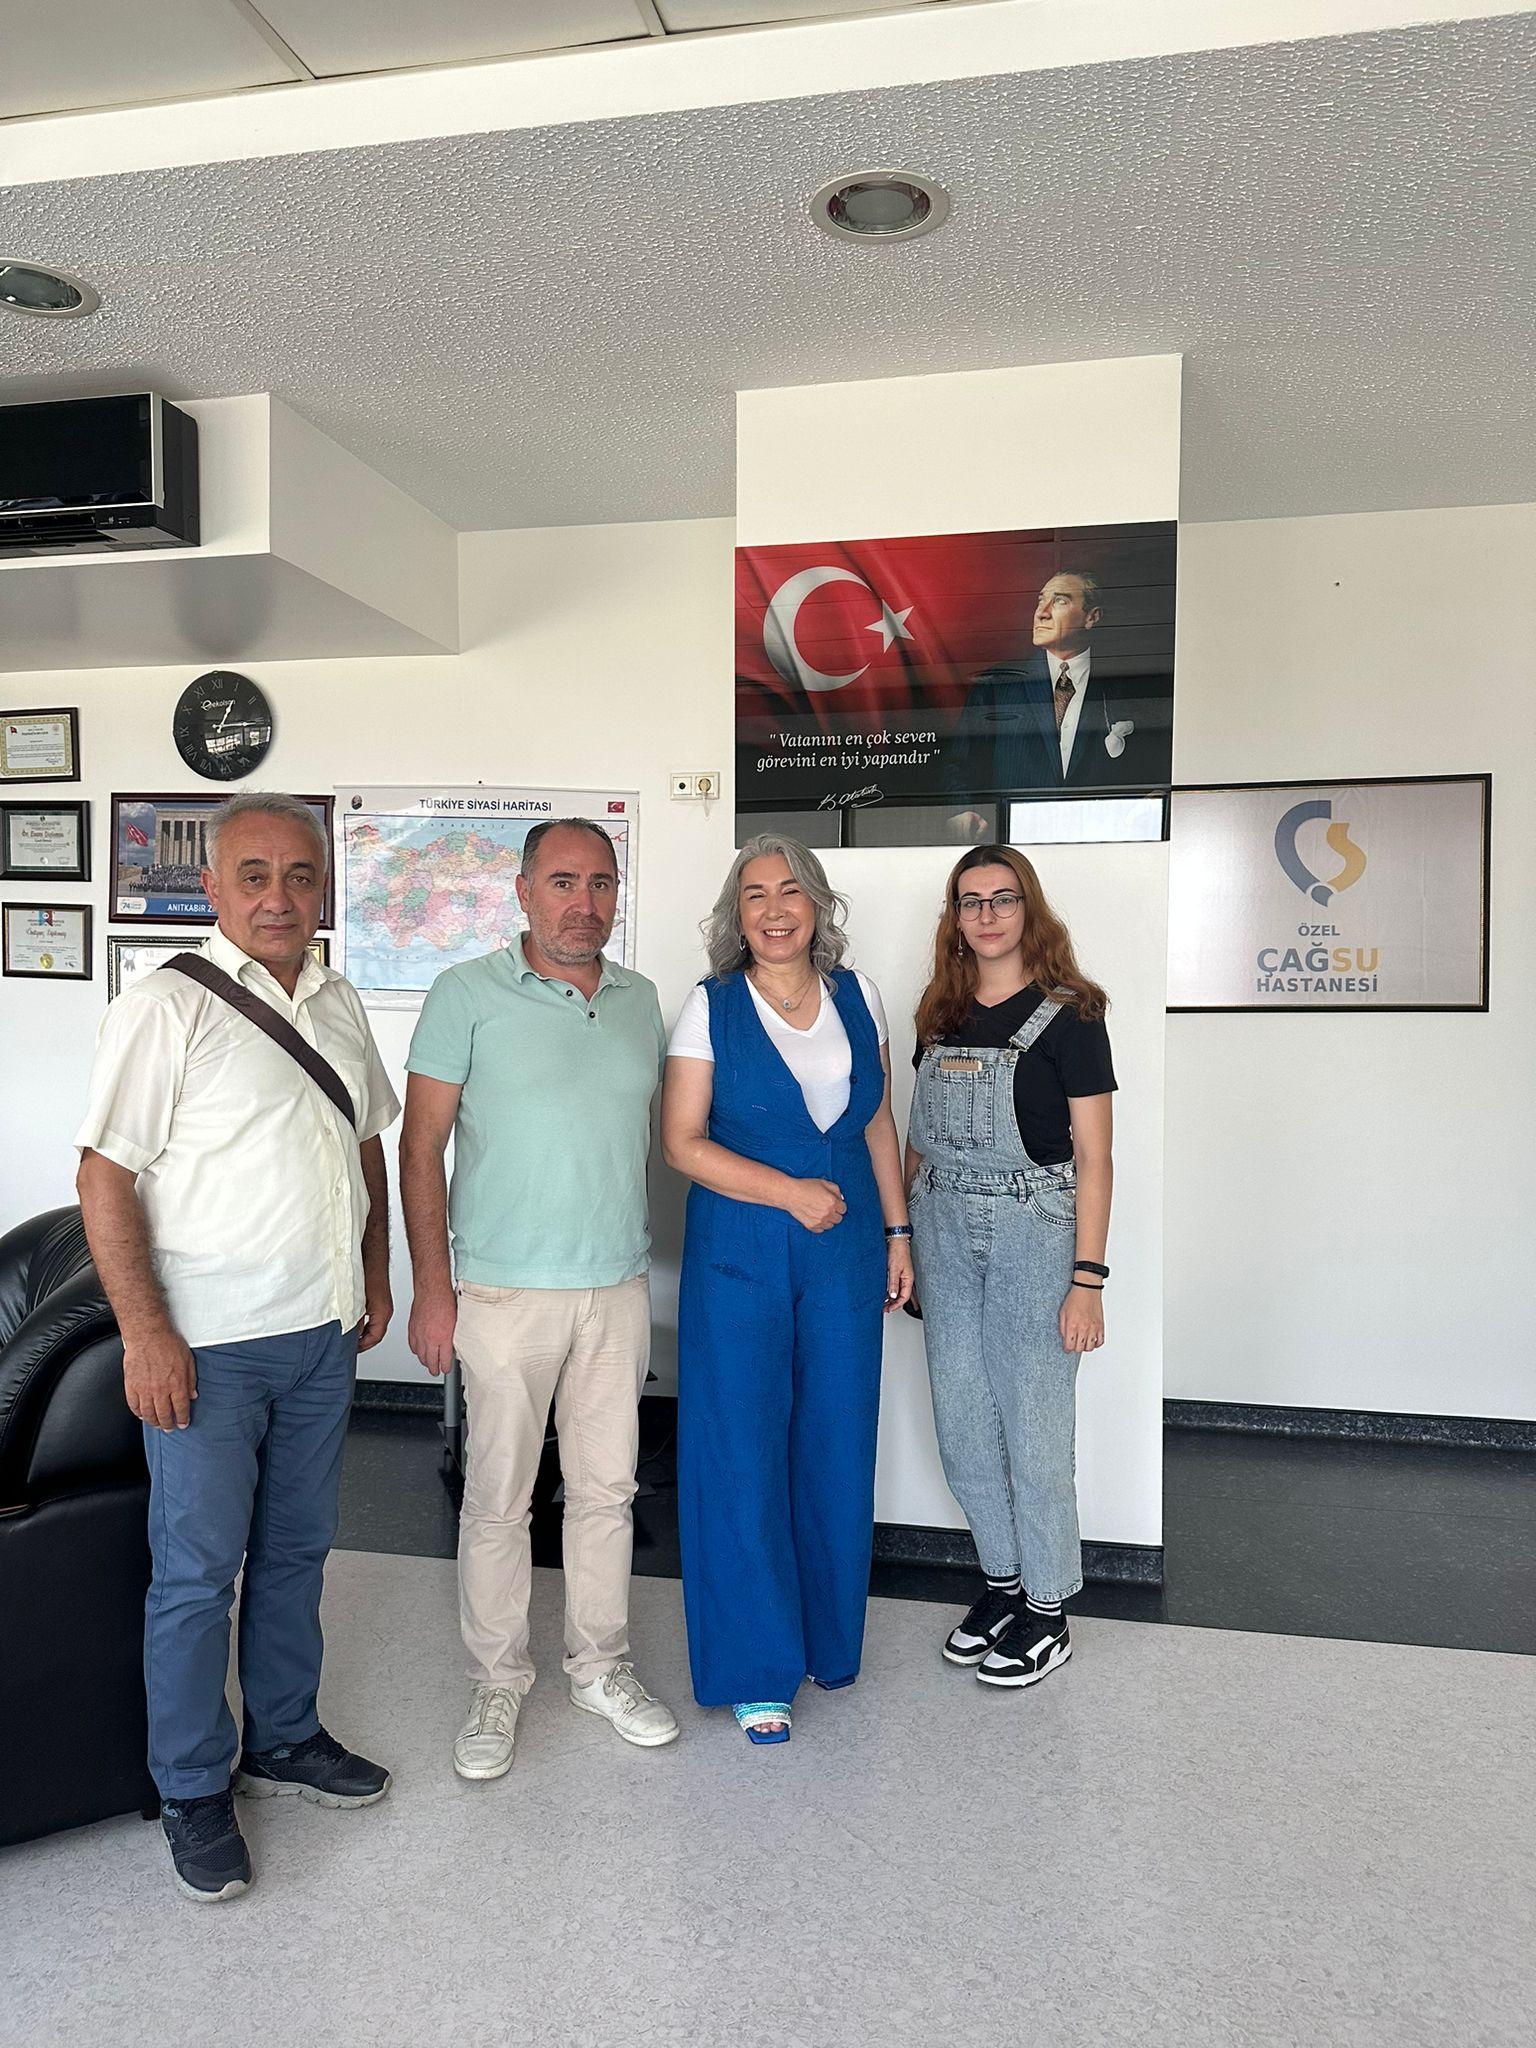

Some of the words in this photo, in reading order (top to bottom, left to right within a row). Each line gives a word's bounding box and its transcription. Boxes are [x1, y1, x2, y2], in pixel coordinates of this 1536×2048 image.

[779, 732, 842, 748] Vatanını
[845, 735, 863, 746] en
[866, 730, 892, 749] çok
[894, 731, 937, 744] seven
[756, 752, 816, 773] görevini
[819, 755, 838, 767] en
[841, 751, 860, 770] iyi
[861, 749, 931, 769] yapandır
[419, 797, 465, 810] TÜRKİYE
[467, 798, 501, 811] SİYASİ
[503, 799, 552, 812] HARİTASI
[167, 903, 206, 913] ANITKABİR
[1297, 922, 1341, 937] ÖZEL
[1256, 941, 1379, 978] ÇAĞSU
[1256, 974, 1379, 992] HASTANESİ
